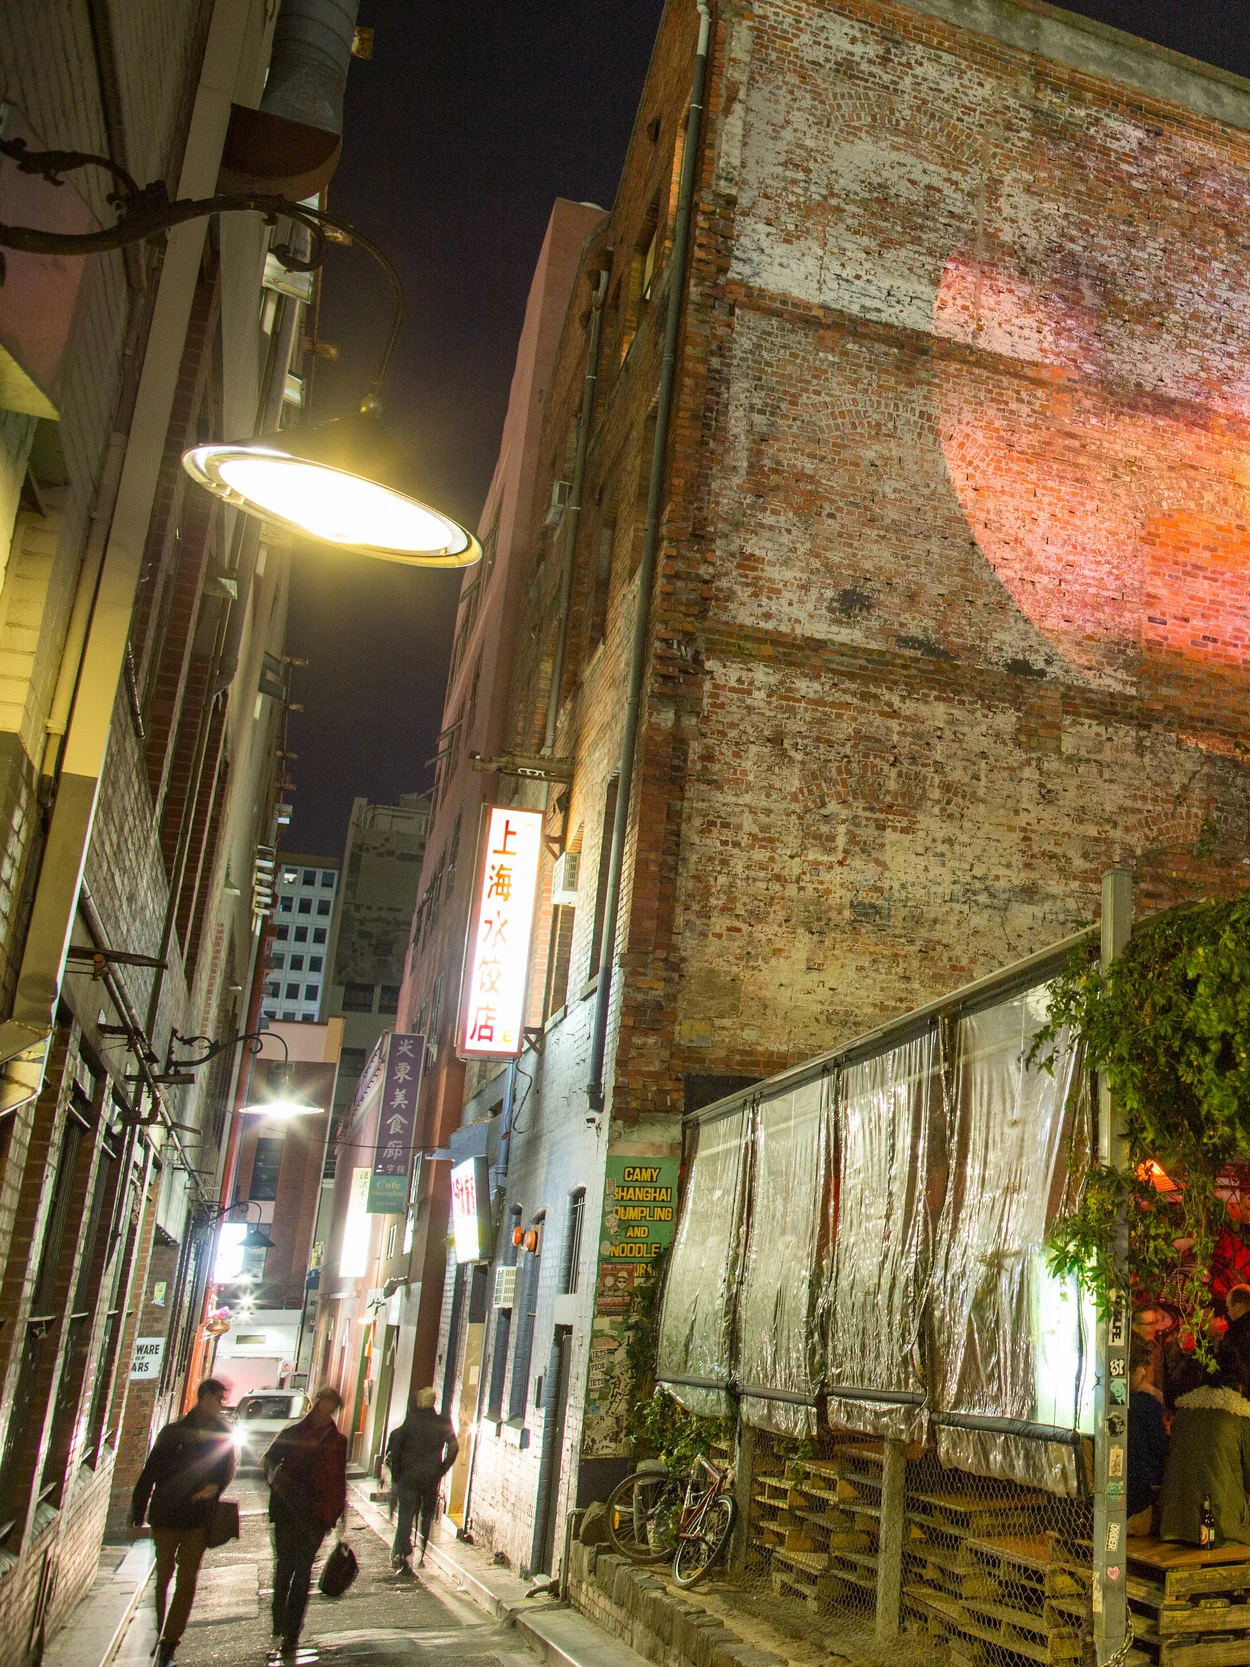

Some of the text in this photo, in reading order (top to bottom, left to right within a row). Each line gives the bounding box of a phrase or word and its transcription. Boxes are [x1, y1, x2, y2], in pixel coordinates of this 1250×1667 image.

[624, 1167, 660, 1182] CAMY
[612, 1187, 672, 1202] SHANGHAI
[613, 1206, 673, 1222] DUMPLING
[625, 1226, 649, 1238] AND
[136, 1344, 160, 1355] WARE
[131, 1362, 150, 1372] ARS
